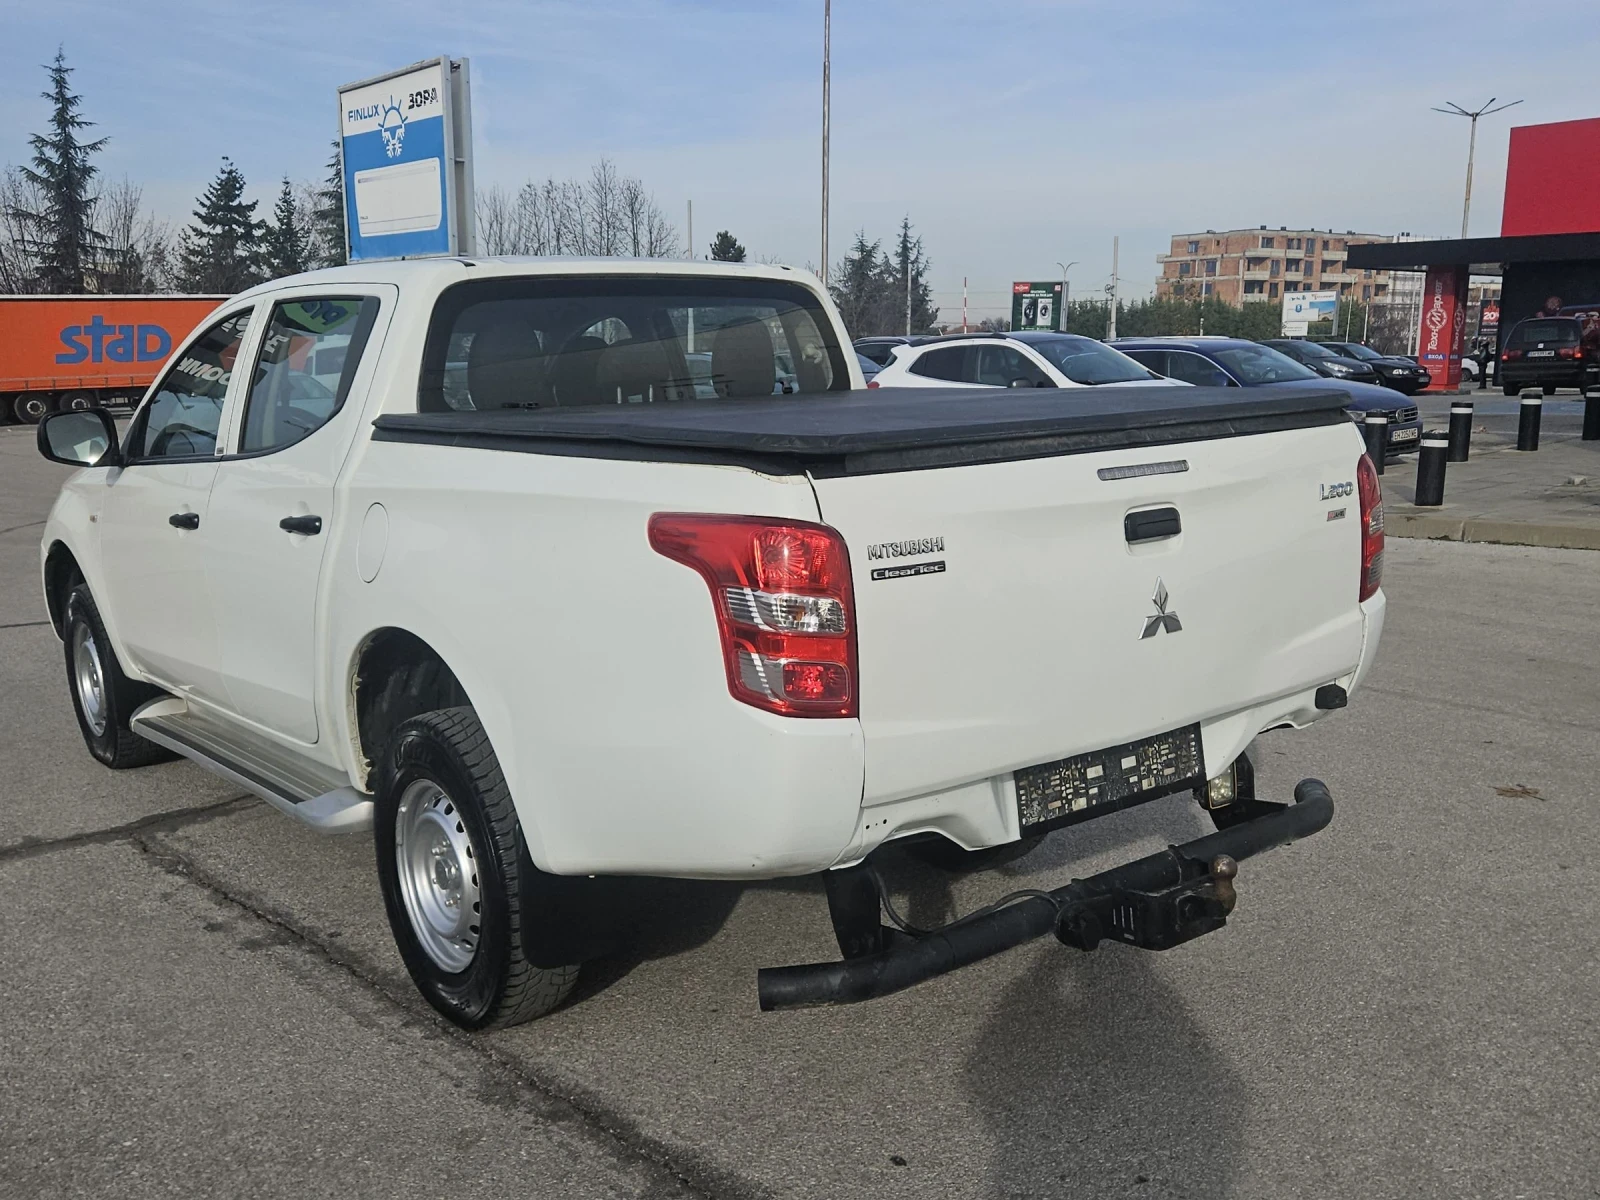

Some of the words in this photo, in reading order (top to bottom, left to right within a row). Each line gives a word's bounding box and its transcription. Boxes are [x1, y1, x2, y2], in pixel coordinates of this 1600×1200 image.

[348, 104, 380, 122] FINLUX
[1319, 481, 1353, 501] L200
[867, 536, 945, 560] MITSUBISHI
[873, 564, 945, 579] ClearTec
